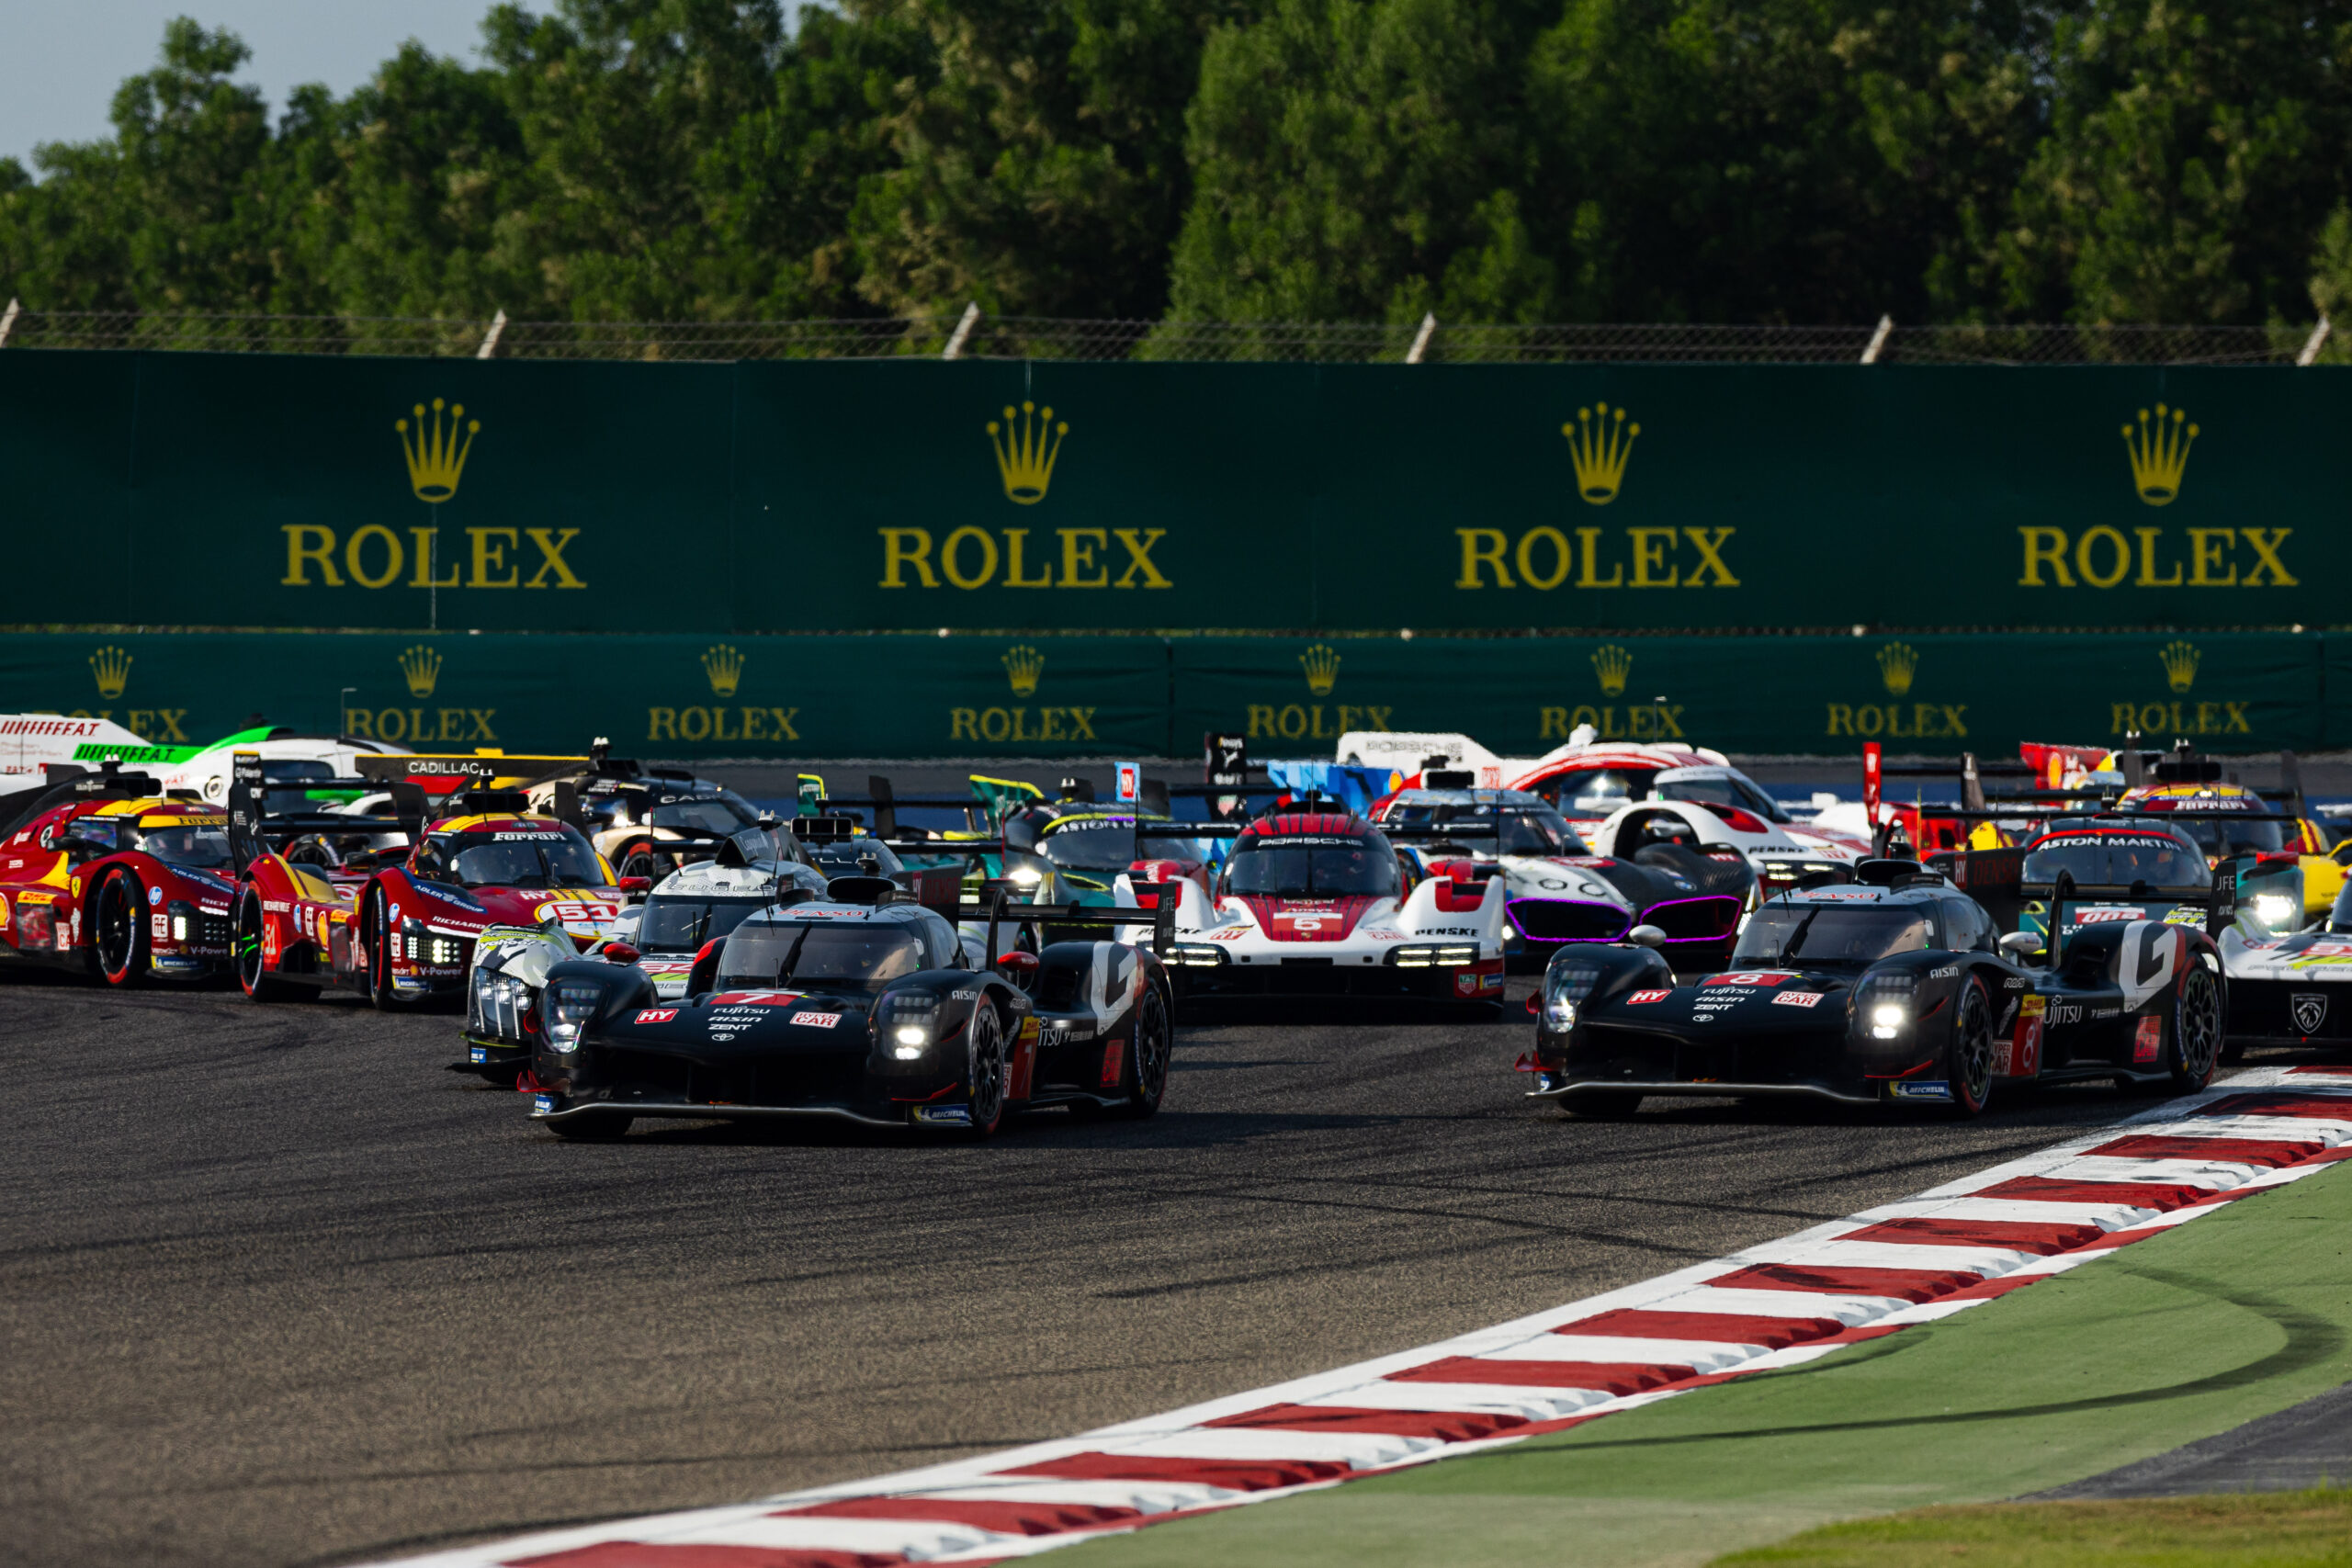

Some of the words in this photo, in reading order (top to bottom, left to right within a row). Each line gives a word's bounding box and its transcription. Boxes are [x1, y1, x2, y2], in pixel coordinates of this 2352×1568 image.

[283, 525, 585, 588] ROLEX
[880, 526, 1171, 589] ROLEX
[1457, 527, 1739, 589] ROLEX
[2019, 526, 2297, 587] ROLEX
[345, 708, 497, 741] ROLEX
[648, 706, 799, 740] ROLEX
[951, 706, 1094, 740] ROLEX
[1247, 705, 1392, 739] ROLEX
[1541, 705, 1684, 739] ROLEX
[1826, 705, 1967, 737] ROLEX
[2111, 702, 2250, 734] ROLEX
[408, 761, 479, 774] CADILLAC
[492, 832, 567, 841] Ferrari
[1258, 838, 1363, 846] PORSCHE
[2038, 837, 2102, 851] ASTON
[2107, 837, 2180, 851] MARTIN
[1955, 860, 1966, 883] HY
[1973, 856, 2018, 886] DENSO
[2217, 875, 2235, 891] JFE
[201, 897, 229, 907] RICH
[413, 885, 443, 898] ADLER
[453, 899, 485, 913] GROUP
[1161, 897, 1175, 912] JFE
[556, 905, 613, 919] 51
[432, 916, 486, 929] RICHARD
[1294, 918, 1321, 931] 5
[266, 923, 276, 955] 51
[1415, 927, 1479, 937] PENSKE
[59, 933, 70, 947] CA
[481, 939, 537, 950] yahoo!
[190, 946, 228, 954] V-Powe
[419, 967, 462, 976] V-Power
[1930, 966, 1959, 979] AISIN
[1730, 974, 1763, 984] 8
[736, 993, 774, 1004] 7
[952, 990, 978, 1001] AISIN
[1632, 991, 1667, 1001] HY
[1777, 997, 1812, 1006] CAR
[639, 1012, 673, 1022] HY
[713, 1006, 771, 1014] FUJITSU
[2043, 995, 2083, 1029] UJITSU
[795, 1017, 831, 1026] CAR
[1993, 1043, 2011, 1055] YPER
[2022, 1023, 2036, 1068] 8
[1020, 1044, 1033, 1092] 7
[1992, 1055, 2009, 1074] AR
[932, 1109, 965, 1118] MICHELIN
